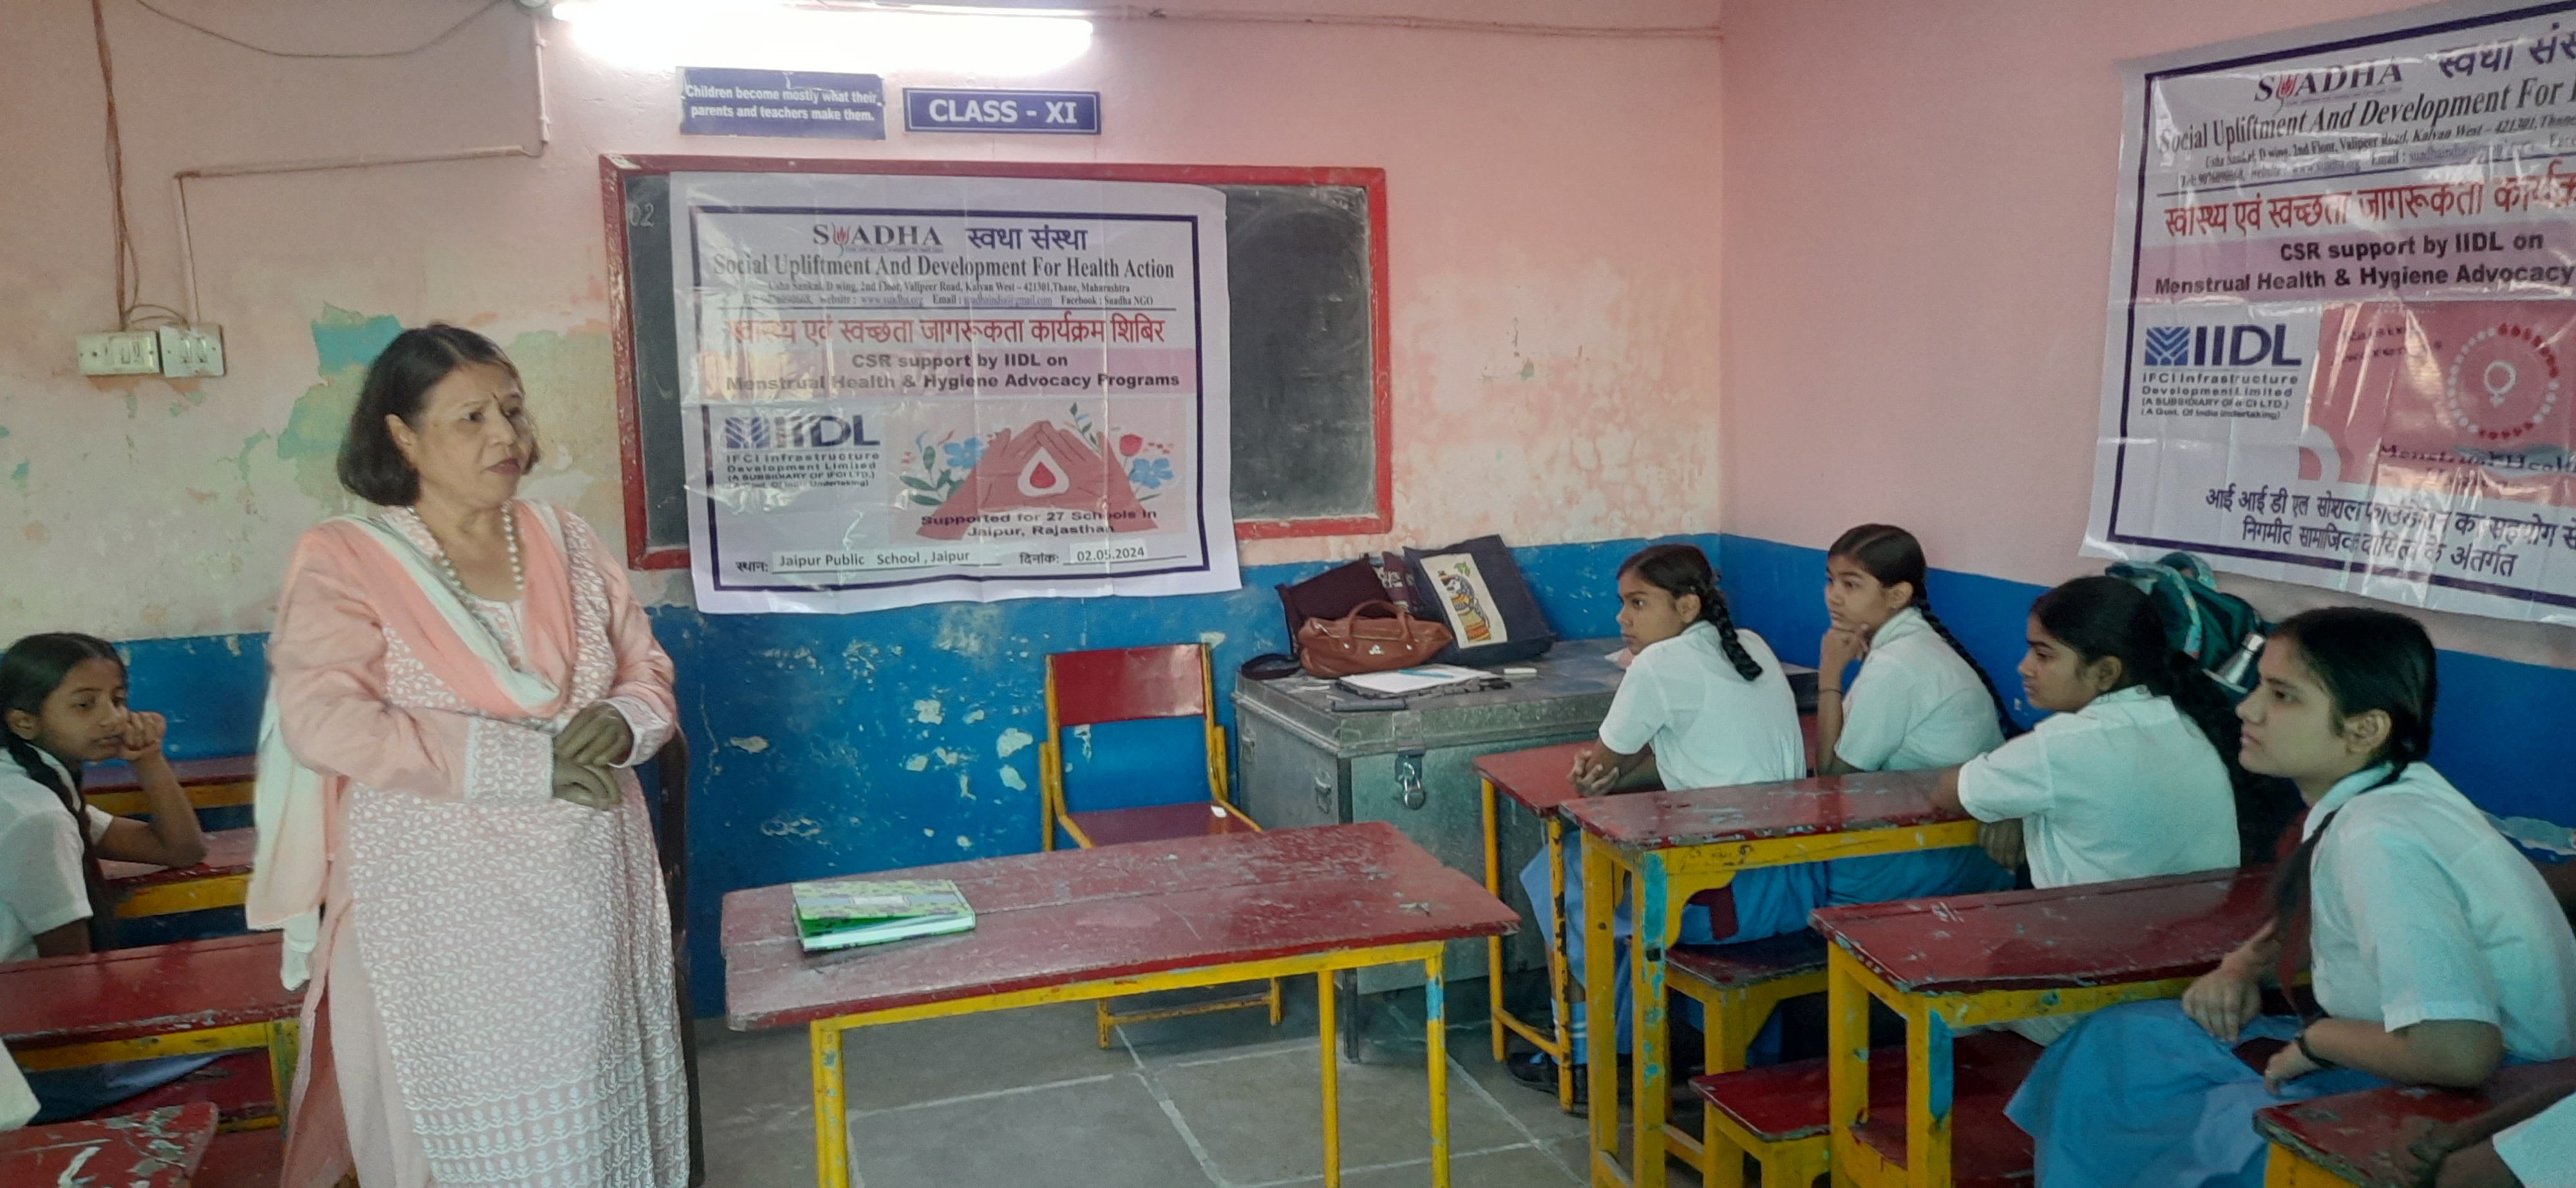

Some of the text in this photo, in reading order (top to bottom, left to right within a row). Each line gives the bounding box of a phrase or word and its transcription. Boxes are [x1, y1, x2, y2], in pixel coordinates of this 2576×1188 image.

[685, 84, 876, 104] Children become mostly what their
[691, 106, 875, 121] parents and teachers make them.
[929, 99, 1018, 122] CLASS
[1045, 101, 1077, 123] XI
[2159, 123, 2207, 152] Social
[2213, 110, 2307, 151] Upliftment
[2309, 101, 2358, 133] And
[2359, 84, 2511, 127] Development
[2517, 76, 2564, 108] For
[2233, 193, 2262, 236] एवं
[966, 224, 1088, 250] स्वधा संस्था
[2281, 231, 2544, 263] CSR support by IIDL on
[714, 254, 1174, 281] Social Upliftment And Development For Health Action
[940, 282, 963, 292] Road,
[996, 282, 1014, 291] West
[1081, 283, 1130, 292] Maharashtra
[2156, 263, 2575, 295] Menstrual Health & Hygiene Advocacy
[933, 294, 956, 304] Email
[1061, 295, 1097, 305] Facebook
[1134, 296, 1153, 305] NGO
[838, 320, 914, 343] स्वच्छता
[919, 320, 1025, 343] जागरूकता
[1028, 311, 1106, 343] कार्यक्रम
[1110, 312, 1165, 343] शिबिर
[2194, 323, 2302, 366] IIDL
[852, 354, 1068, 370] CSR support by IIDL on
[726, 373, 1179, 391] Menstrual Health & Hygiene Advocacy Programs
[2143, 372, 2298, 384] IFCI Infrastructure
[2142, 386, 2293, 399] Development Limited
[765, 452, 880, 463] Infrastructure
[726, 461, 876, 475] Development Limited
[2206, 483, 2236, 512] आई
[2239, 484, 2268, 515] आई
[2270, 487, 2288, 513] डी
[2292, 495, 2310, 517] एल
[922, 515, 1010, 526] Supported
[1016, 512, 1041, 522] for
[1046, 512, 1064, 521] 27
[1072, 510, 1136, 521] Schools
[966, 524, 1115, 538] Jaipur, Rajasthan
[780, 555, 820, 568] Jaipur
[826, 553, 865, 566] Public
[877, 553, 920, 565] School
[931, 551, 970, 564] Jaipur
